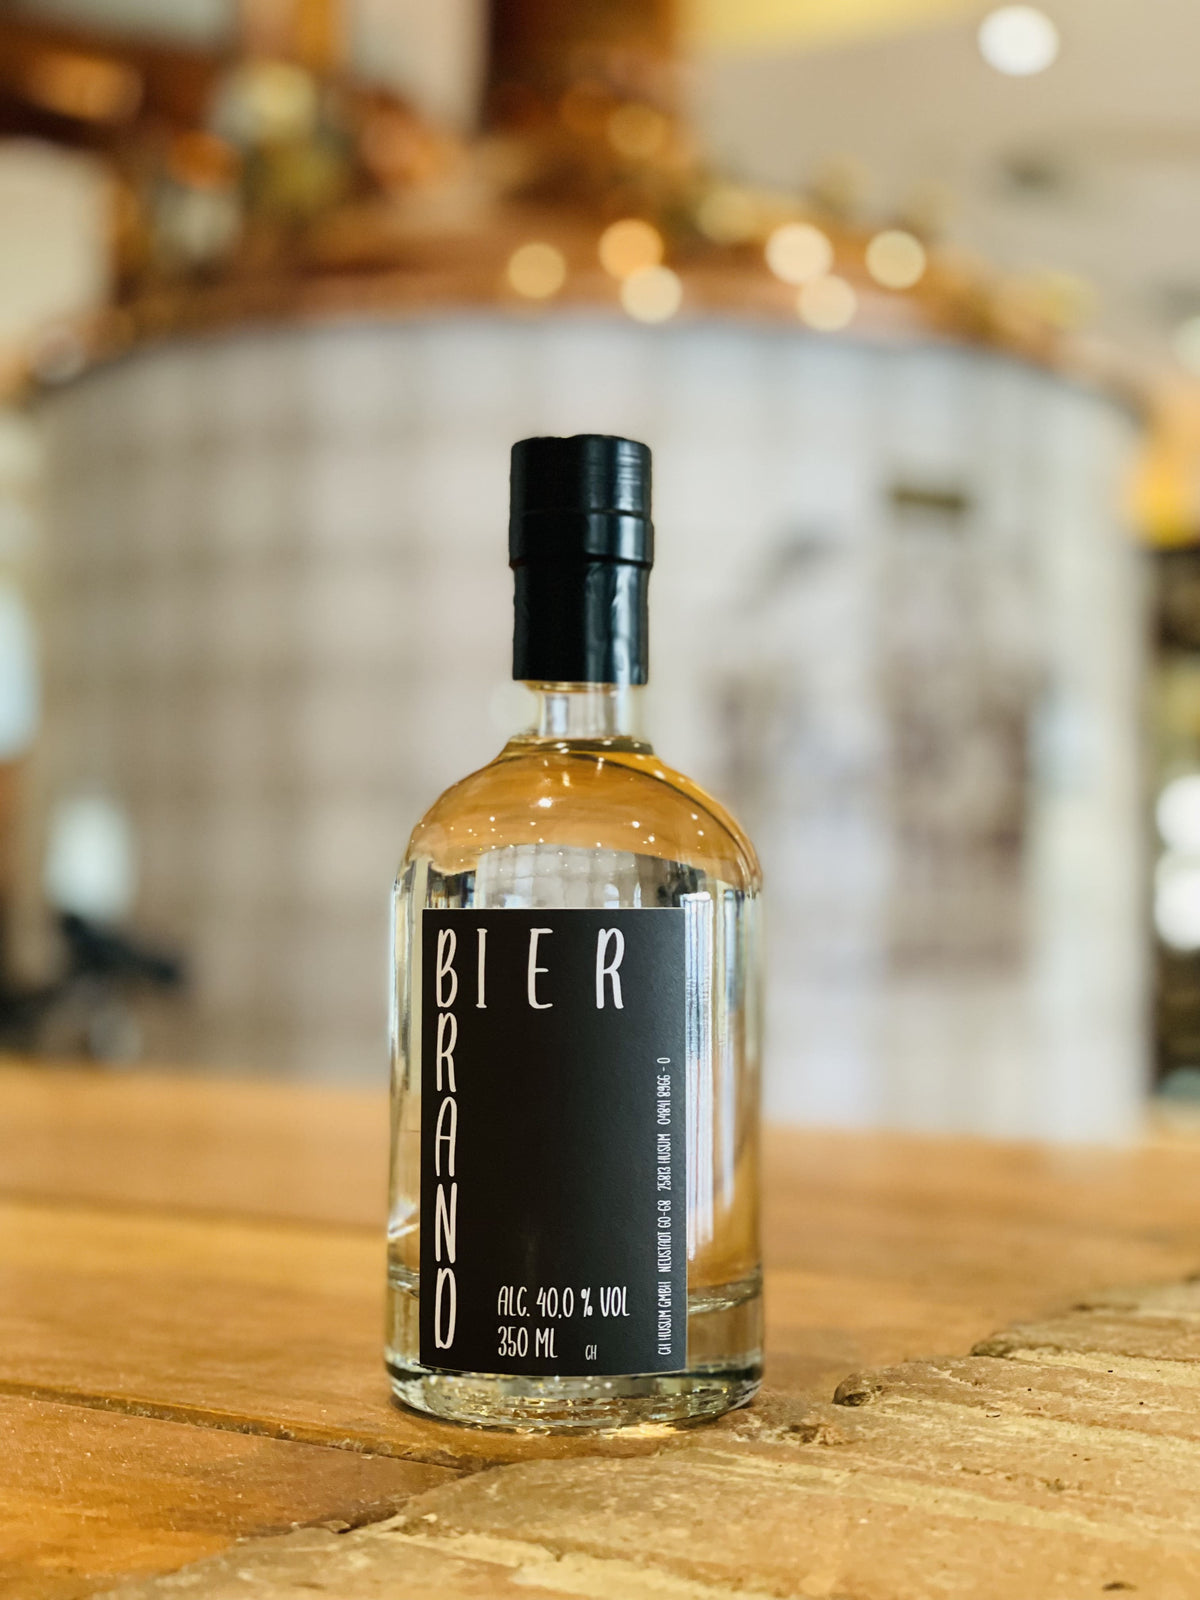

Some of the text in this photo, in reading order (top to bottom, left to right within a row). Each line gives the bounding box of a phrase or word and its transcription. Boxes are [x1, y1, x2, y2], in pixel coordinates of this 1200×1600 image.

[437, 928, 624, 1010] BIER
[657, 1100, 672, 1125] 04841
[657, 1133, 672, 1165] HUSUM
[657, 1166, 672, 1192] 25813
[657, 1231, 672, 1273] NEUSTADT
[497, 1285, 531, 1317] ALC.
[580, 1288, 593, 1318] %
[600, 1285, 631, 1317] VOL
[657, 1281, 672, 1308] GMBH
[657, 1310, 672, 1341] HUSUM
[497, 1326, 559, 1359] 350 ML
[585, 1344, 598, 1361] CH
